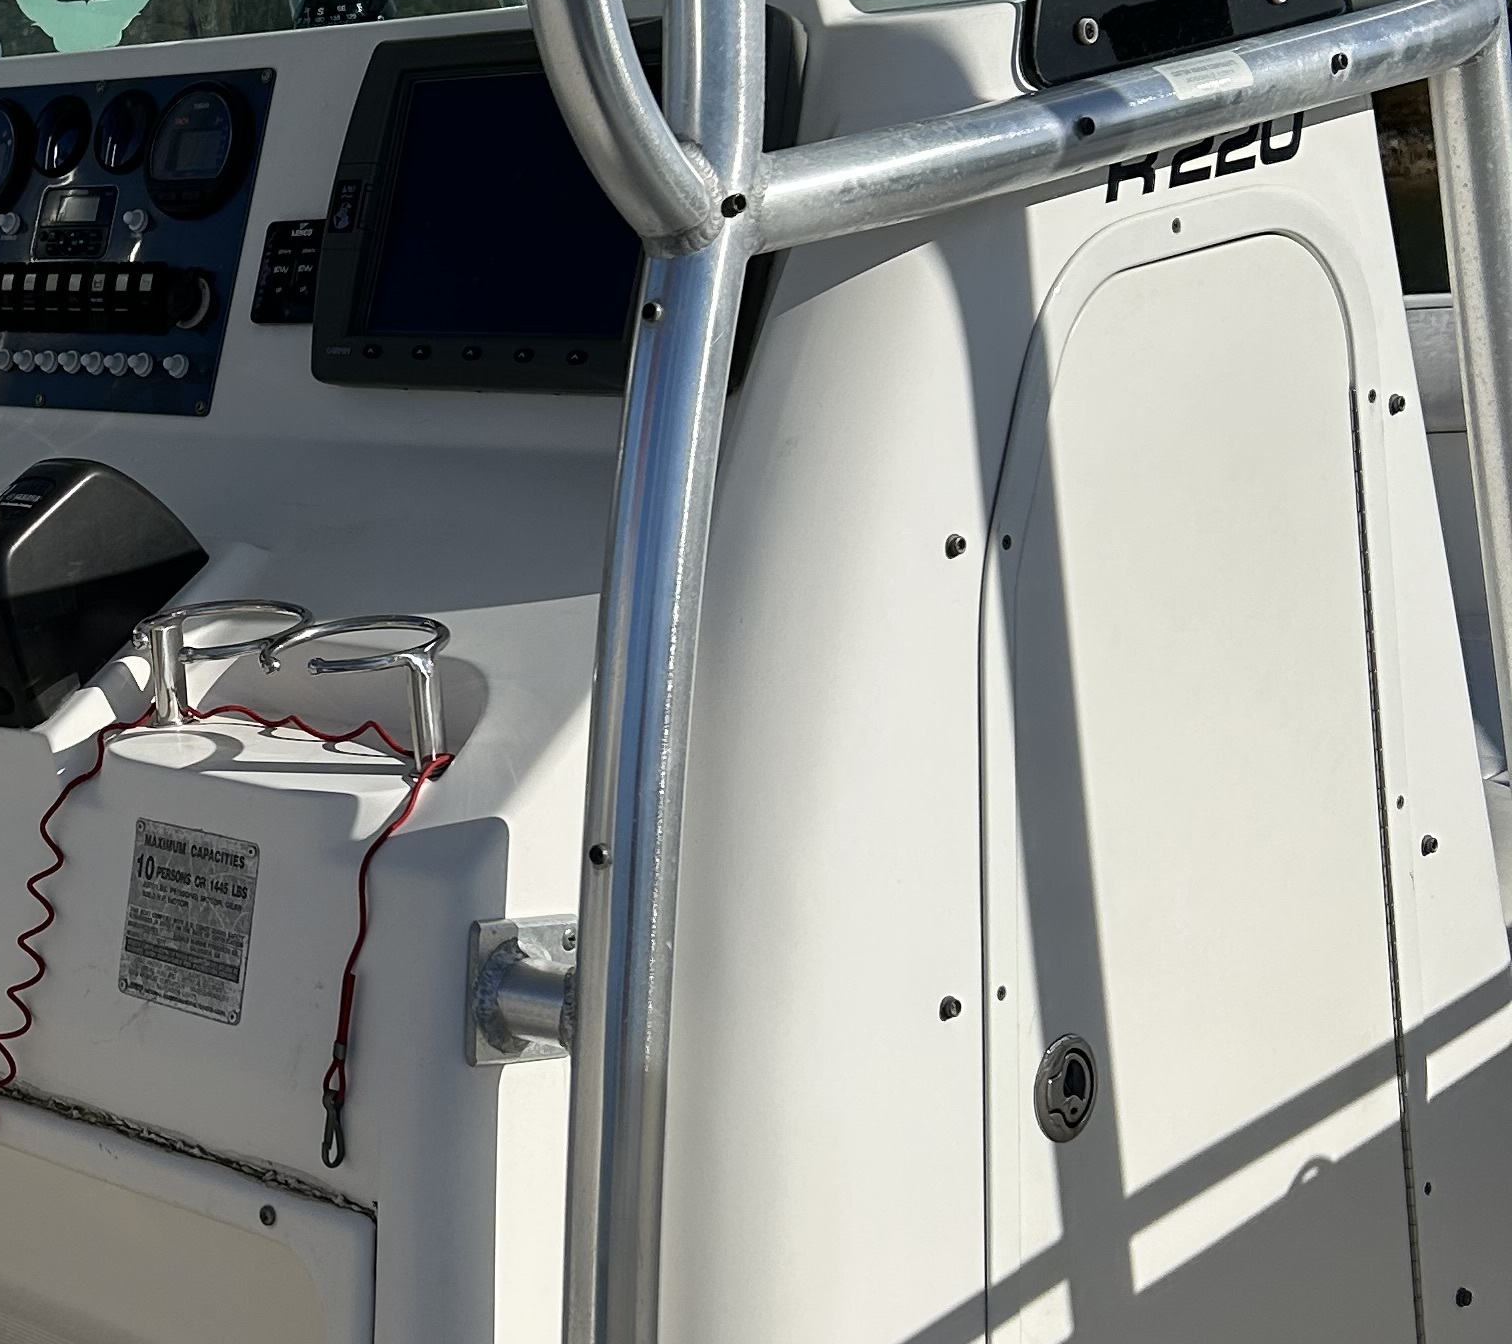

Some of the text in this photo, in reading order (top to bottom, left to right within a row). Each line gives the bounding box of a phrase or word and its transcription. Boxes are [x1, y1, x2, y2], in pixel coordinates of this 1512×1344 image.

[144, 834, 245, 869] MAXIMUM CAPACITIES
[137, 853, 155, 880] 10
[155, 865, 192, 887] PERSONS
[210, 880, 229, 895] 1445
